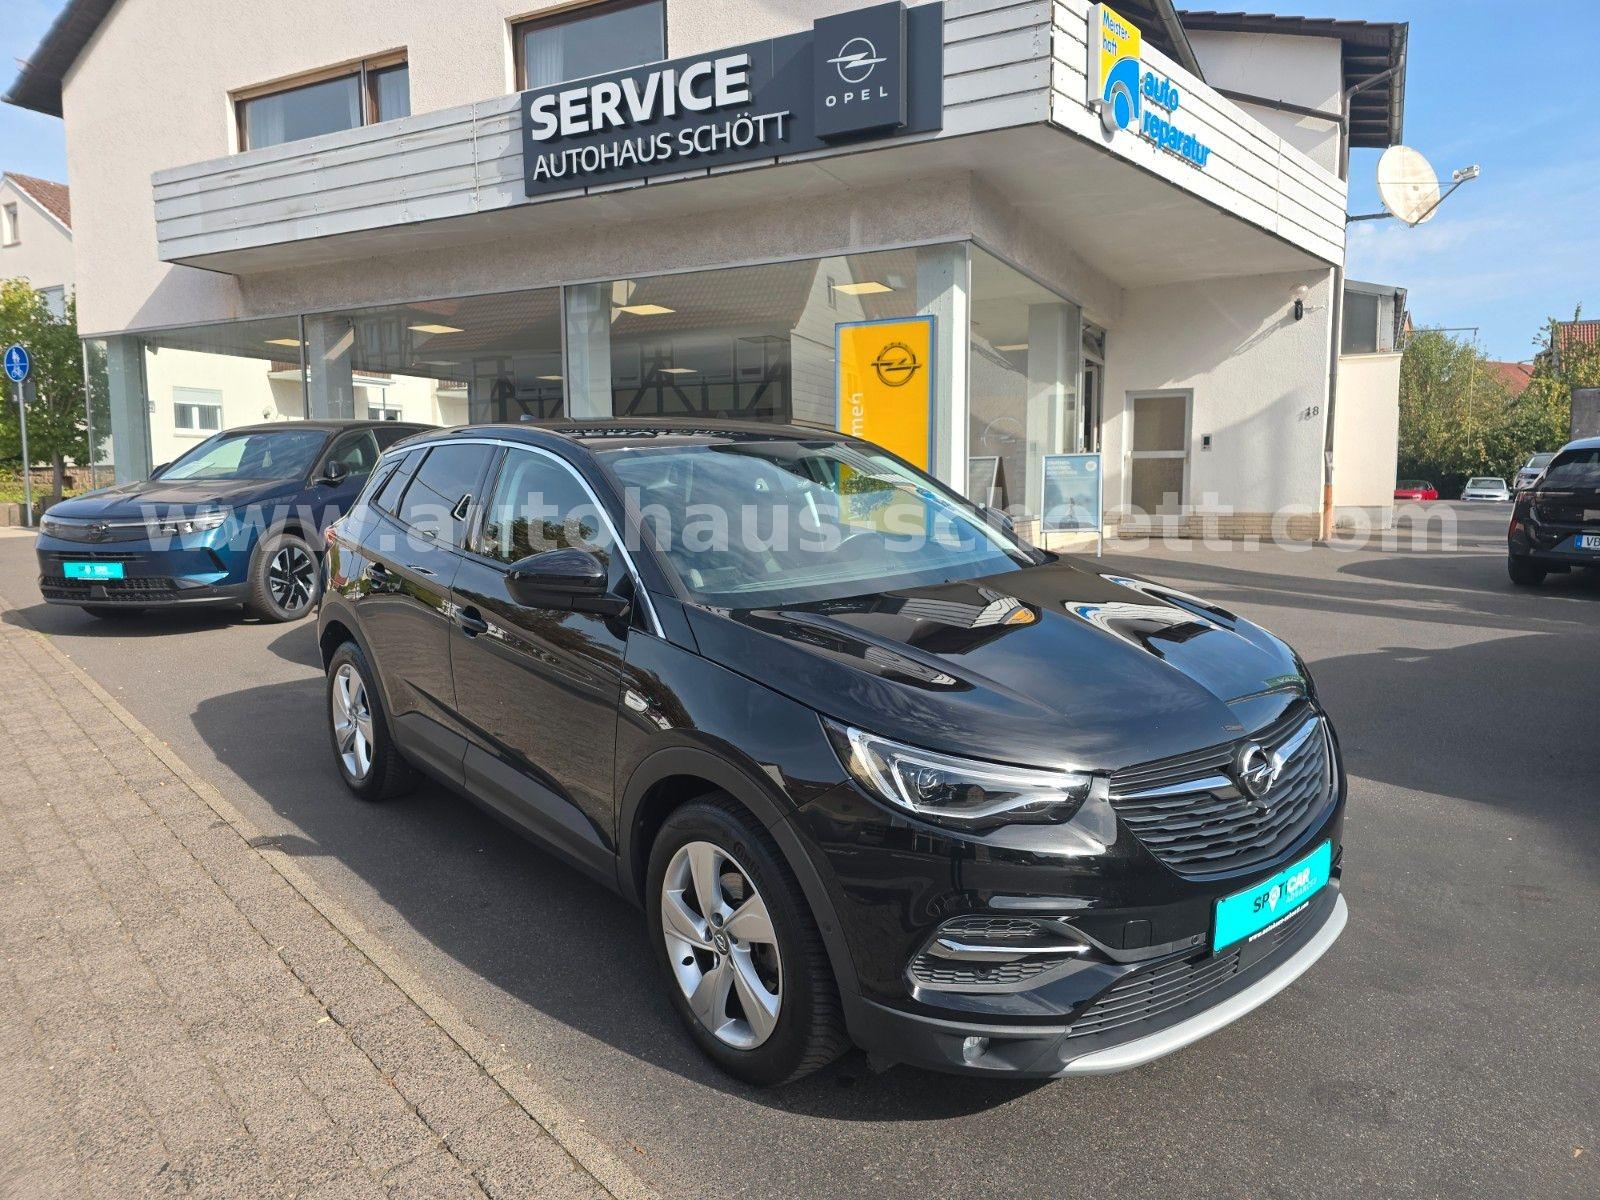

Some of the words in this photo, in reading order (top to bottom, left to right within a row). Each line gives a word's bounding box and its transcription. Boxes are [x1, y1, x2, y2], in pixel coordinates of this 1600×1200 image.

[531, 53, 750, 142] SERVICE
[825, 86, 889, 108] OPEL
[1143, 71, 1180, 112] auto
[532, 132, 673, 181] AUTOHAUS
[678, 110, 791, 156] SCHÖTT
[1143, 109, 1212, 168] reparatur
[1253, 866, 1311, 913] SPOTICAR
